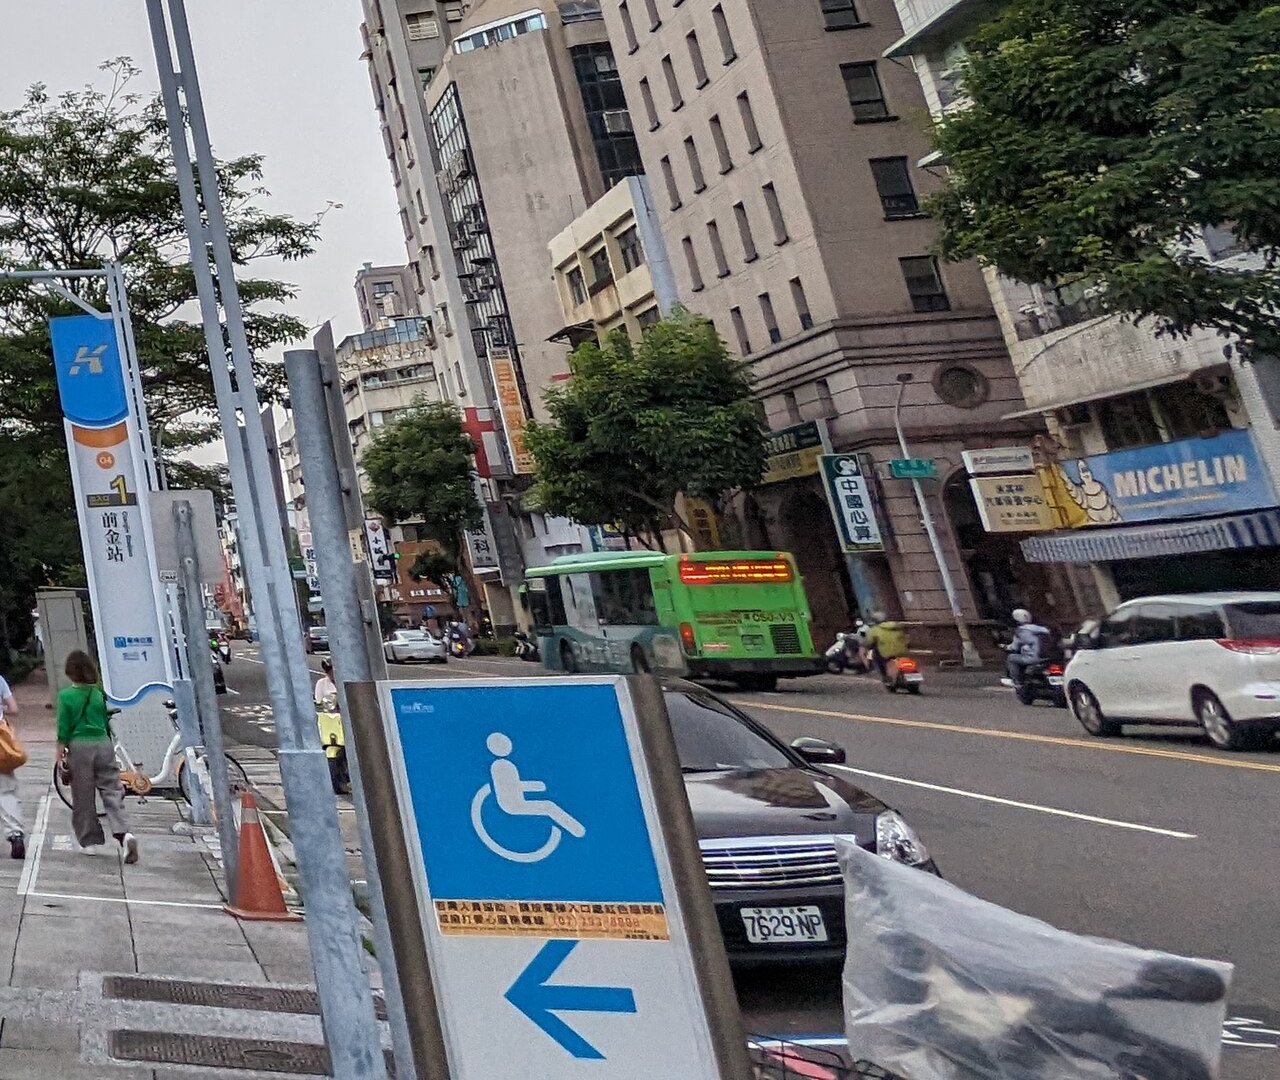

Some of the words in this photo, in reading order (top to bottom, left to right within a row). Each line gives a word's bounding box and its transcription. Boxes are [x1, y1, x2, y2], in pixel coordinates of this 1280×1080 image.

[110, 474, 128, 506] 1
[1113, 454, 1247, 498] MICHELIN
[102, 511, 124, 563] 前金站
[743, 914, 821, 938] 7629-NP
